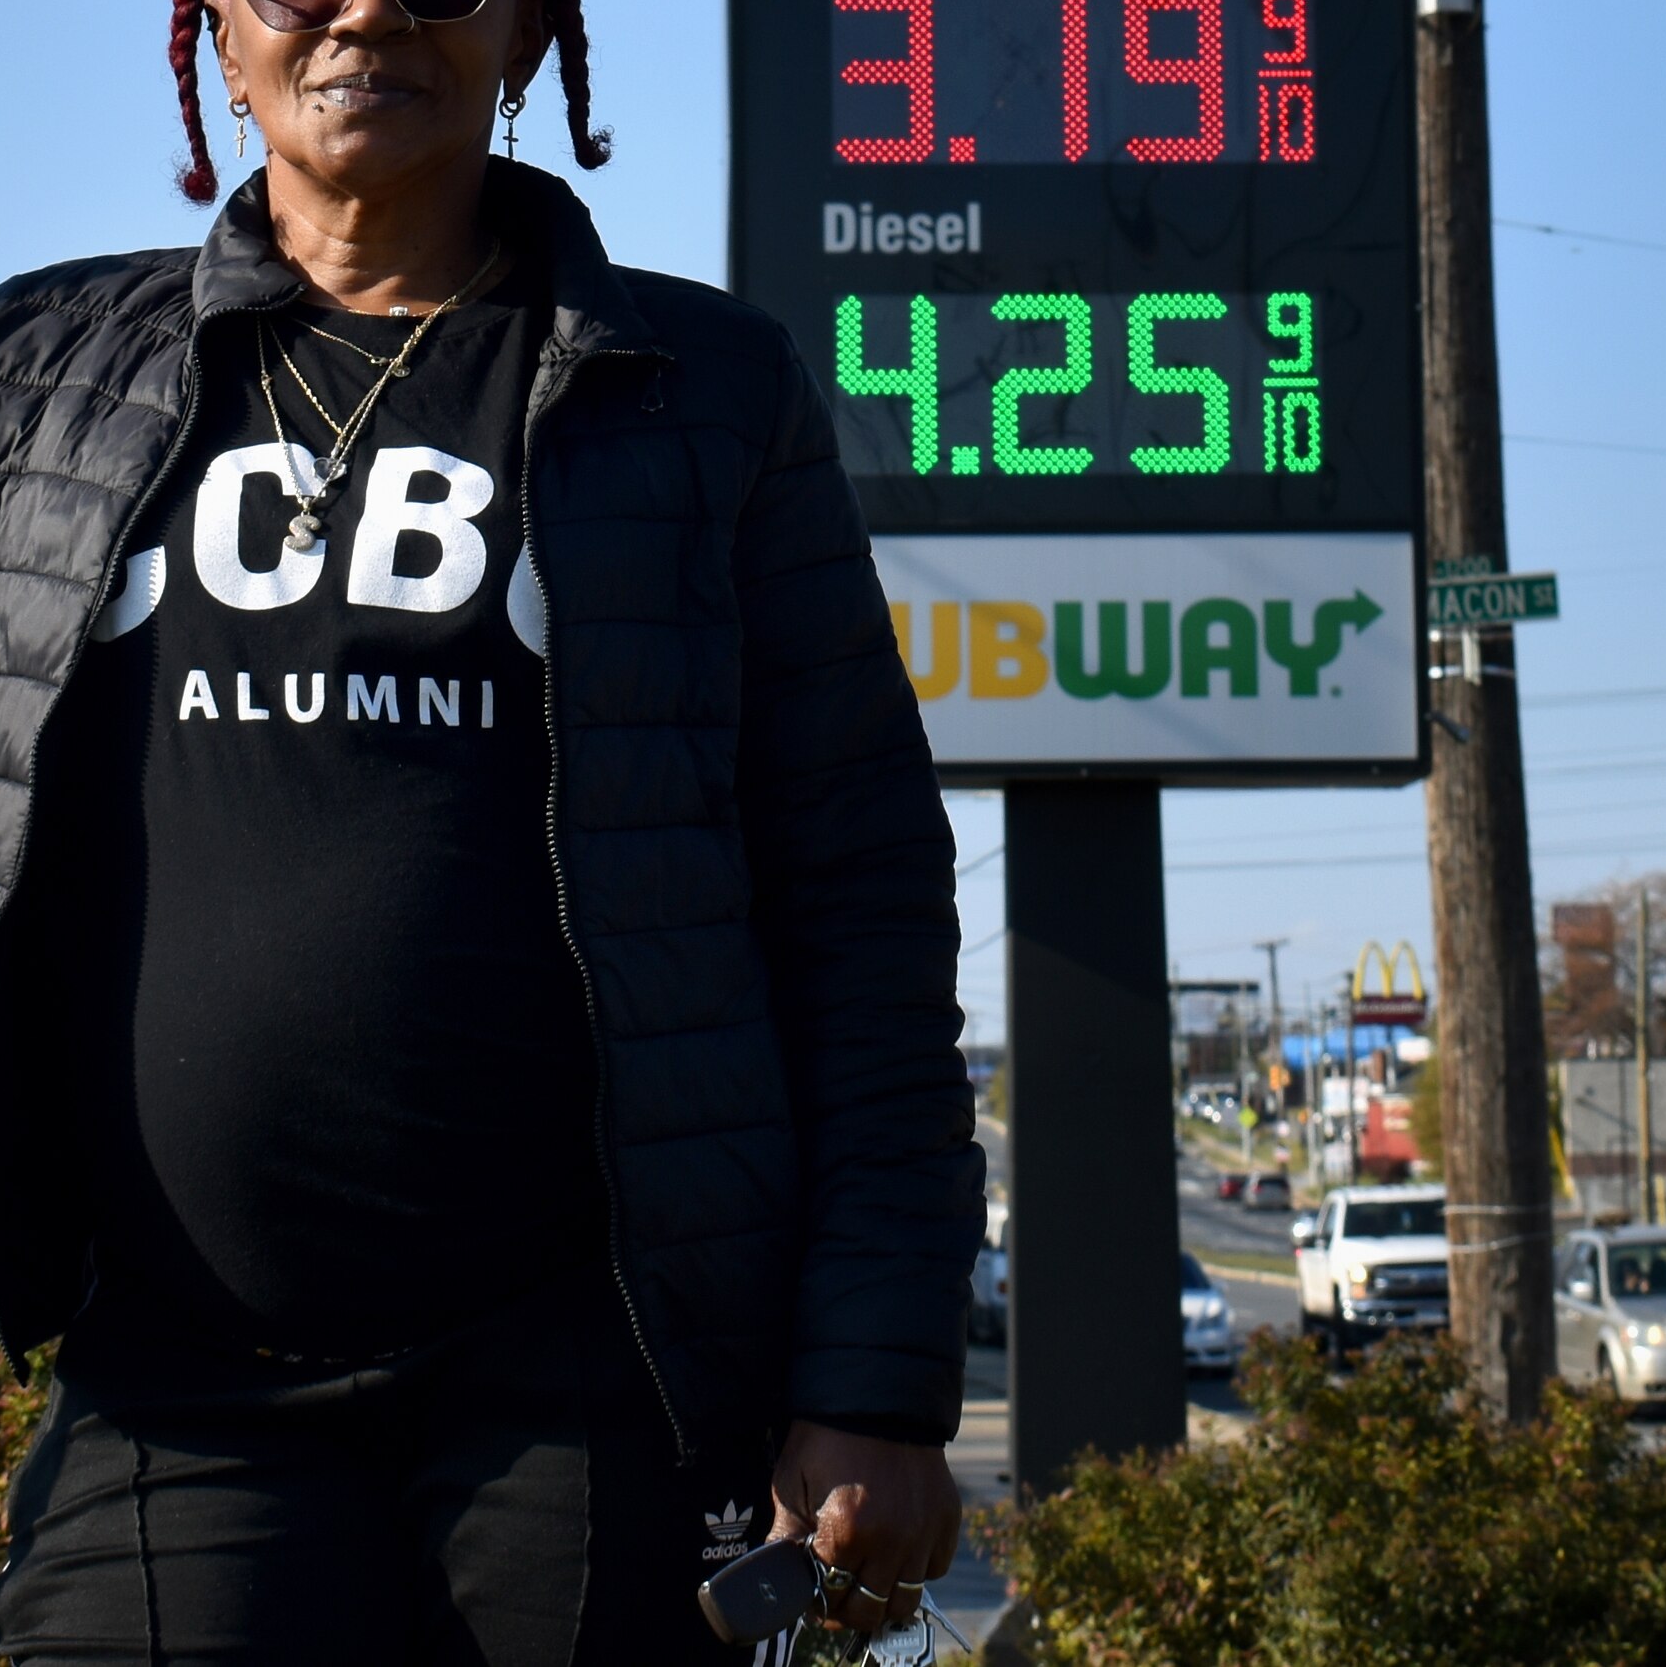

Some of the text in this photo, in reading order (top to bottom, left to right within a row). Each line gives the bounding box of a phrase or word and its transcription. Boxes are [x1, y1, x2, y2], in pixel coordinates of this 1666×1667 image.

[822, 203, 982, 253] Diesel
[835, 293, 1231, 475] 4.25
[178, 669, 494, 728] ALUMNI
[702, 1541, 749, 1561] adidas
